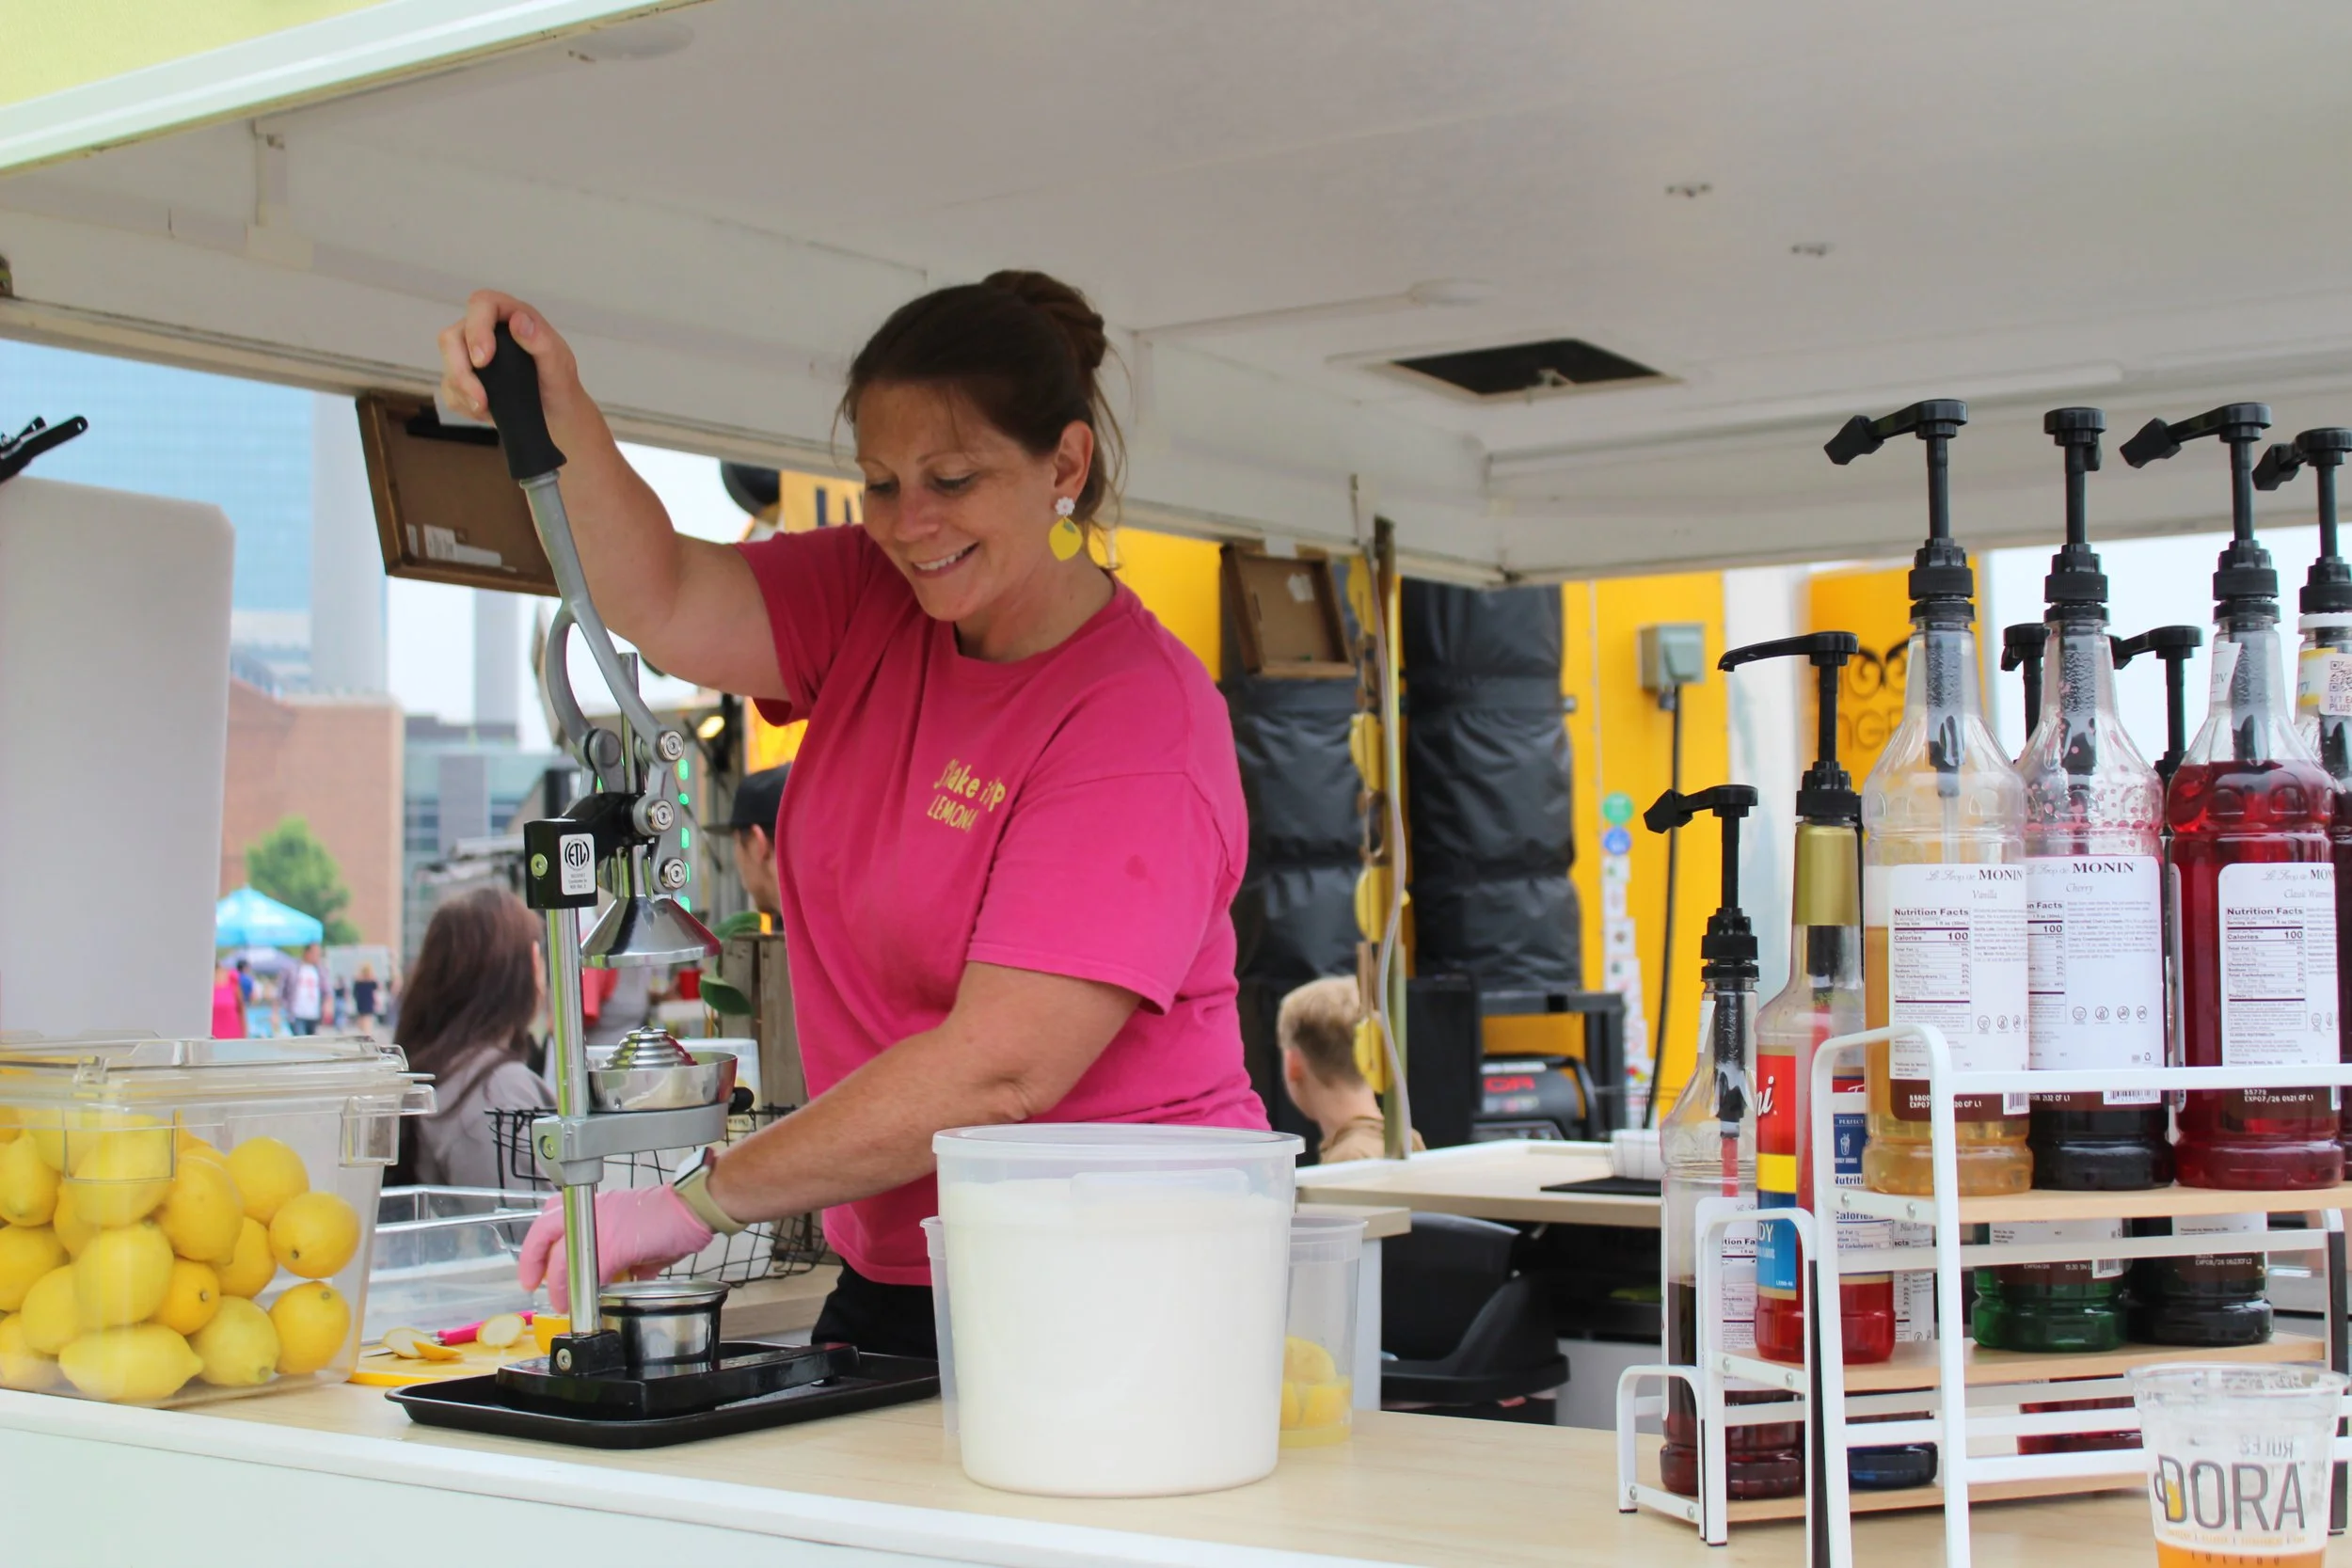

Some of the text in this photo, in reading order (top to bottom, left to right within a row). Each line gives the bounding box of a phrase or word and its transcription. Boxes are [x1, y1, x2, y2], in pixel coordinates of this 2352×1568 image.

[568, 843, 587, 867] ETL
[2073, 863, 2135, 873] MONIN
[1979, 869, 2023, 881] MONIN
[1972, 889, 1997, 899] Vanilla
[2066, 882, 2093, 895] Cherry
[1948, 932, 1969, 940] 100
[1758, 1221, 1773, 1242] DY
[2155, 1454, 2305, 1531] DORA
